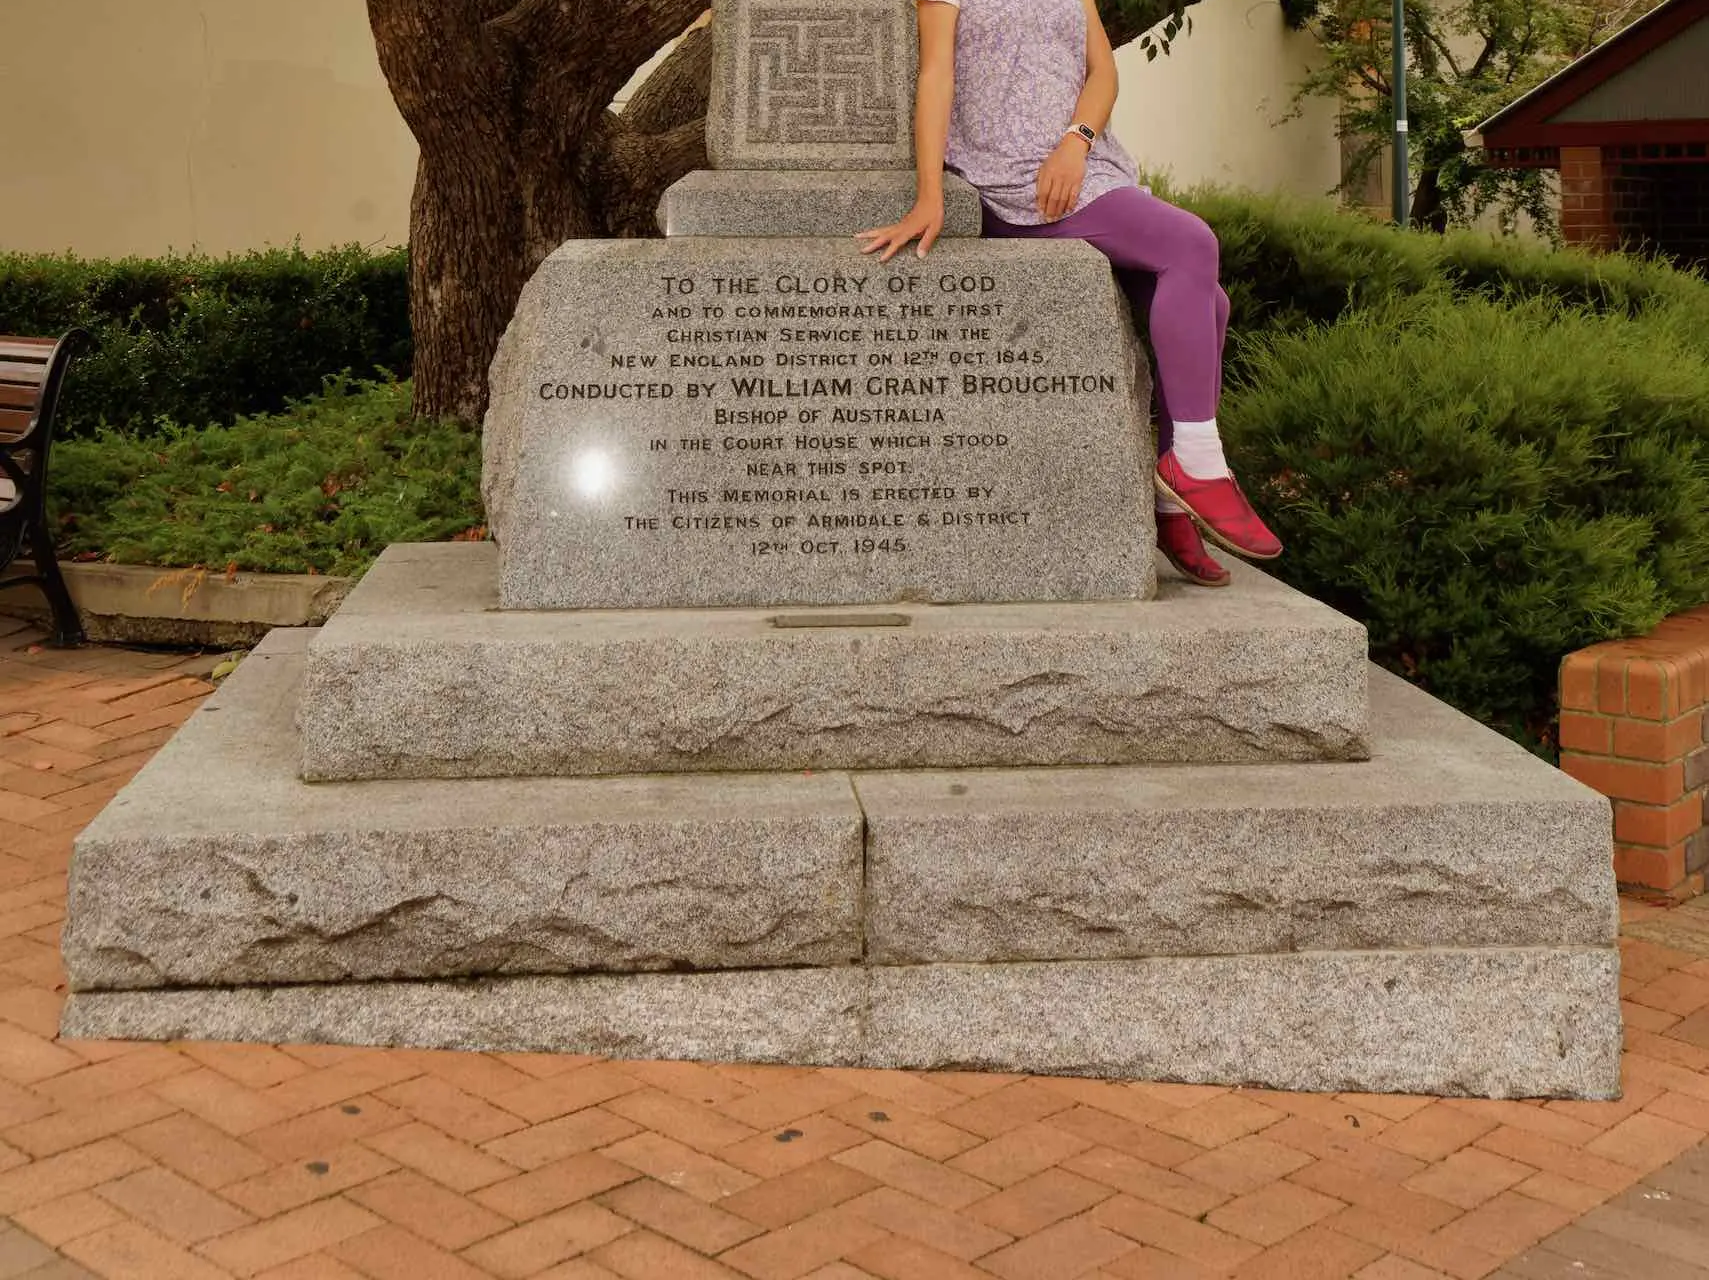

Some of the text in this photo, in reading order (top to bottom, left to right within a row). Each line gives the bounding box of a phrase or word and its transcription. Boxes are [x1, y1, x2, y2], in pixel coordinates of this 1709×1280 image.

[661, 275, 995, 294] TO THE GLORY OF GOD
[652, 304, 1003, 318] AND TO COMMEMORATE THE FIRST
[667, 328, 991, 342] CHRISTIAN SERVICE HELD IN THE
[611, 354, 657, 368] NEW
[670, 354, 765, 367] ENGLAND
[776, 352, 857, 368] DISTRICT
[868, 353, 893, 366] ON
[539, 374, 1115, 400] CONDUCTED BY WILLIAM GRANT BROUGHTON
[715, 407, 945, 424] BISHOP OF AUSTRALIA
[650, 434, 1009, 451] IN THE COURT HOUSE WHICH STOOD
[747, 463, 797, 476] NEAR
[808, 462, 846, 474] THIS
[668, 486, 994, 503] THIS MEMORIAL IS ERECTED BY
[624, 511, 1031, 530] THE CITIZENS OF ARMIDALE & DISTRICT
